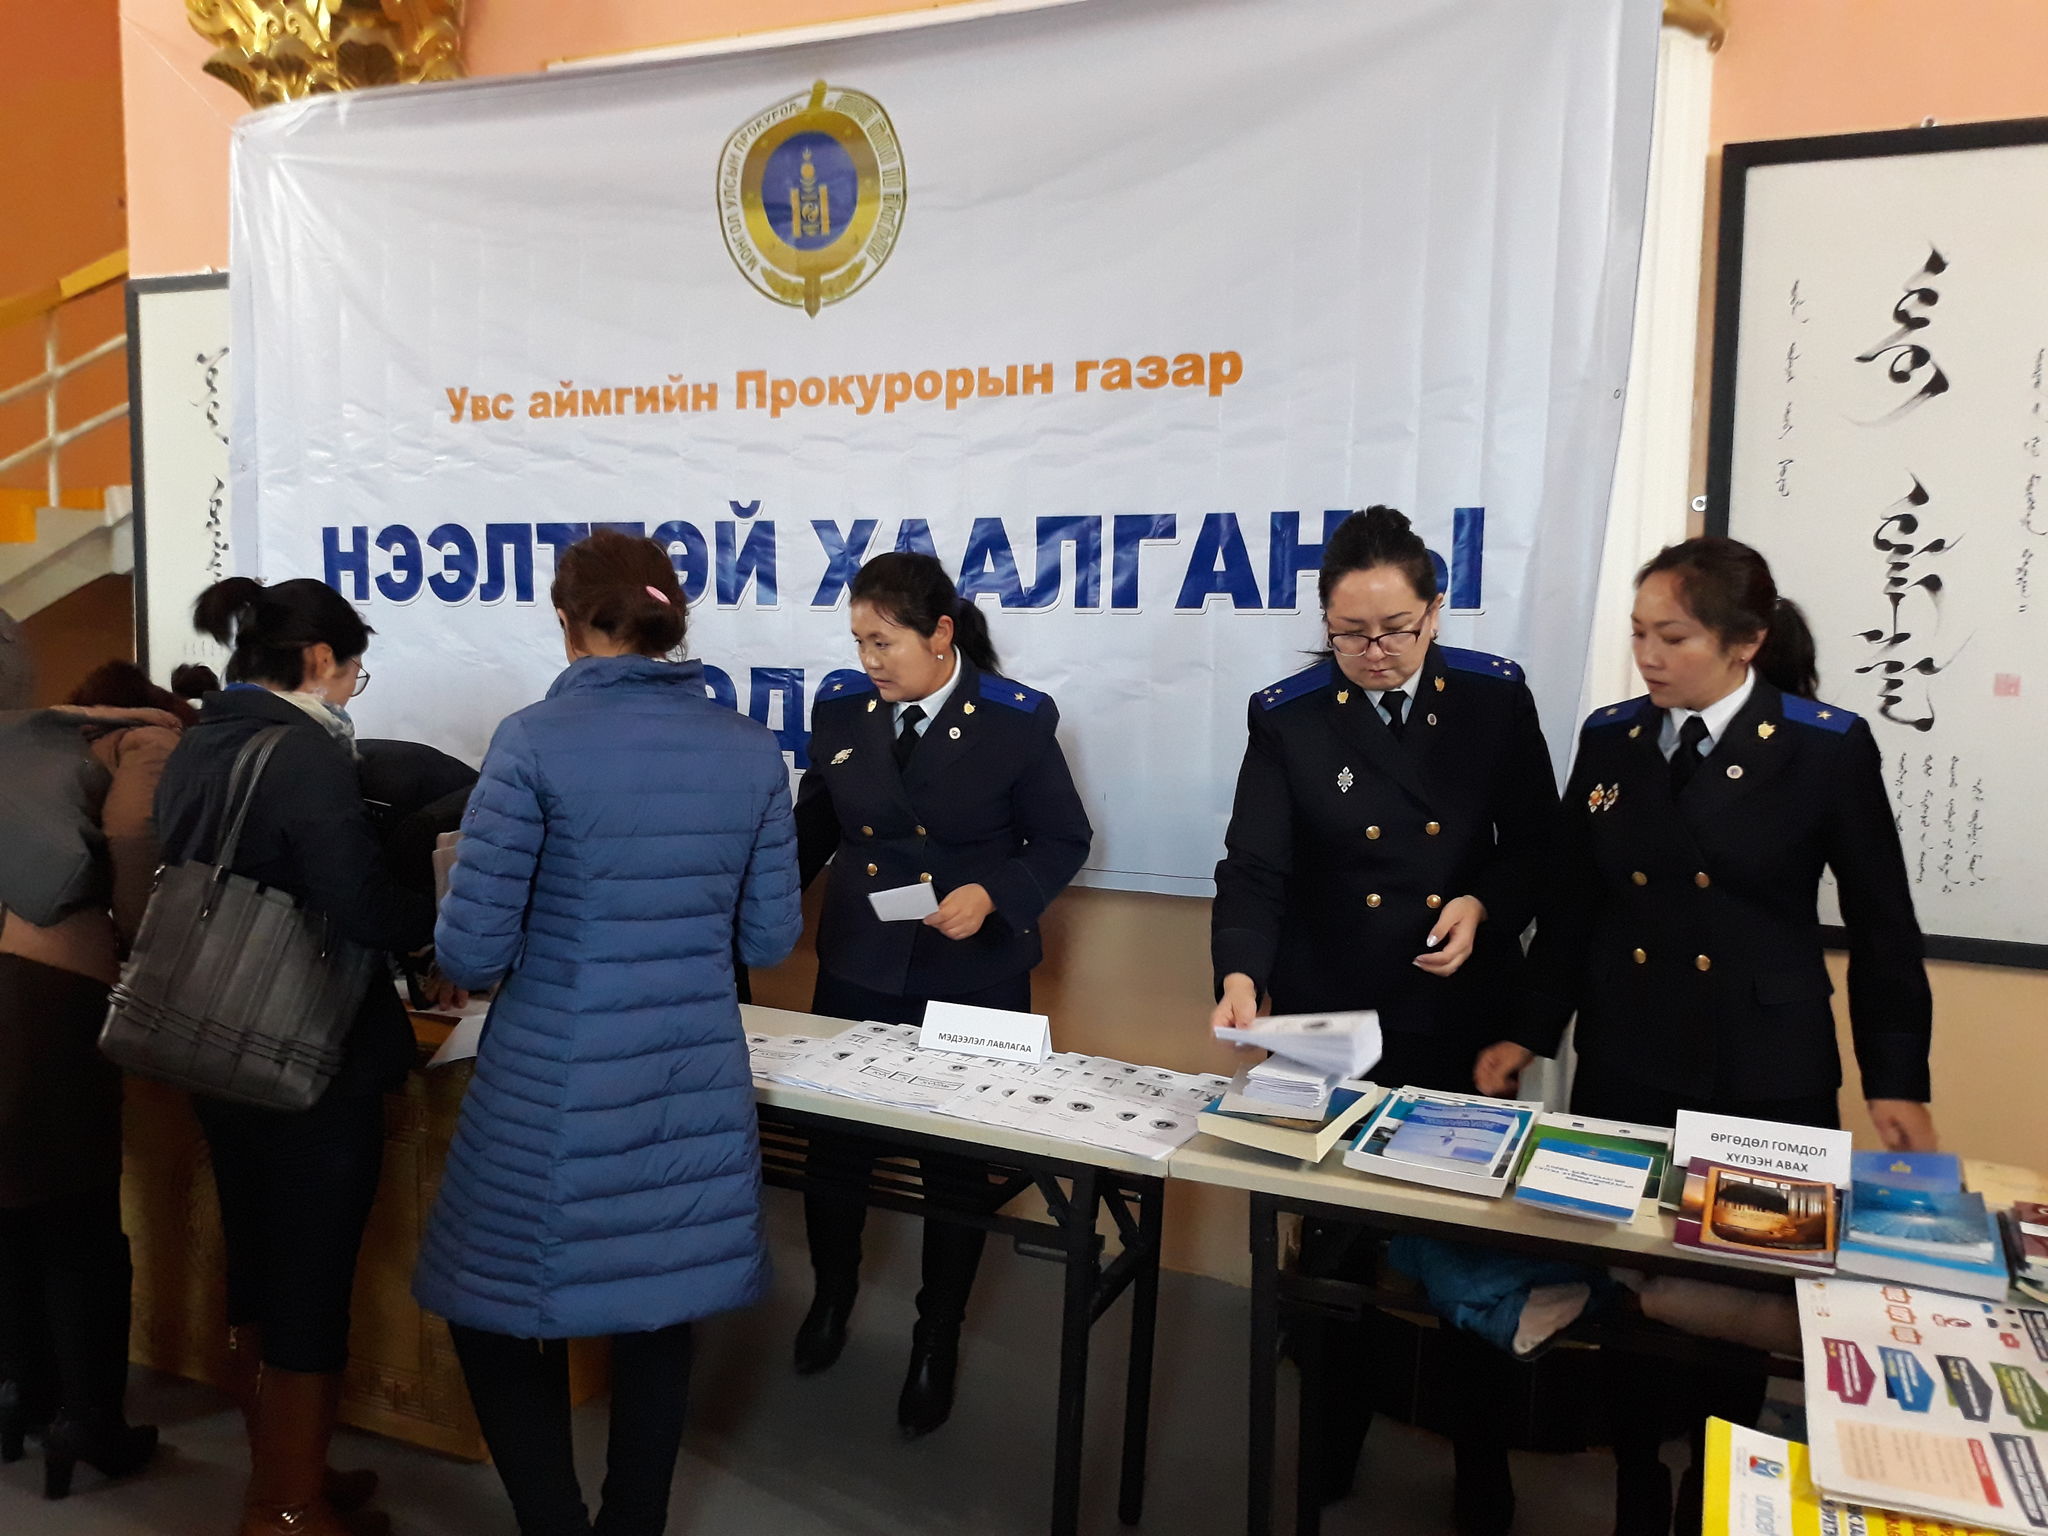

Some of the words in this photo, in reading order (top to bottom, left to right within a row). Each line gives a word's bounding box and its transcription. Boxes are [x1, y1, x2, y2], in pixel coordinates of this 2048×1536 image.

[723, 154, 740, 207] УЛСЫН
[728, 214, 758, 271] МОНГОЛ
[445, 386, 515, 424] Увс
[528, 373, 719, 419] аймгийн
[735, 362, 1055, 418] Прокурорын
[1074, 350, 1244, 398] газар
[321, 499, 781, 607] НЭЭЛЭЙ
[937, 1032, 986, 1046] МЭДЭЭЛЭЛ
[986, 1039, 1033, 1054] ЛАВЛАГАА
[1711, 1133, 1769, 1149] ӨРГӨДӨЛ
[1772, 1141, 1827, 1157] ГОМДОЛ
[1726, 1152, 1773, 1168] ХҮЛЭЭН
[1775, 1159, 1809, 1173] АВАХ
